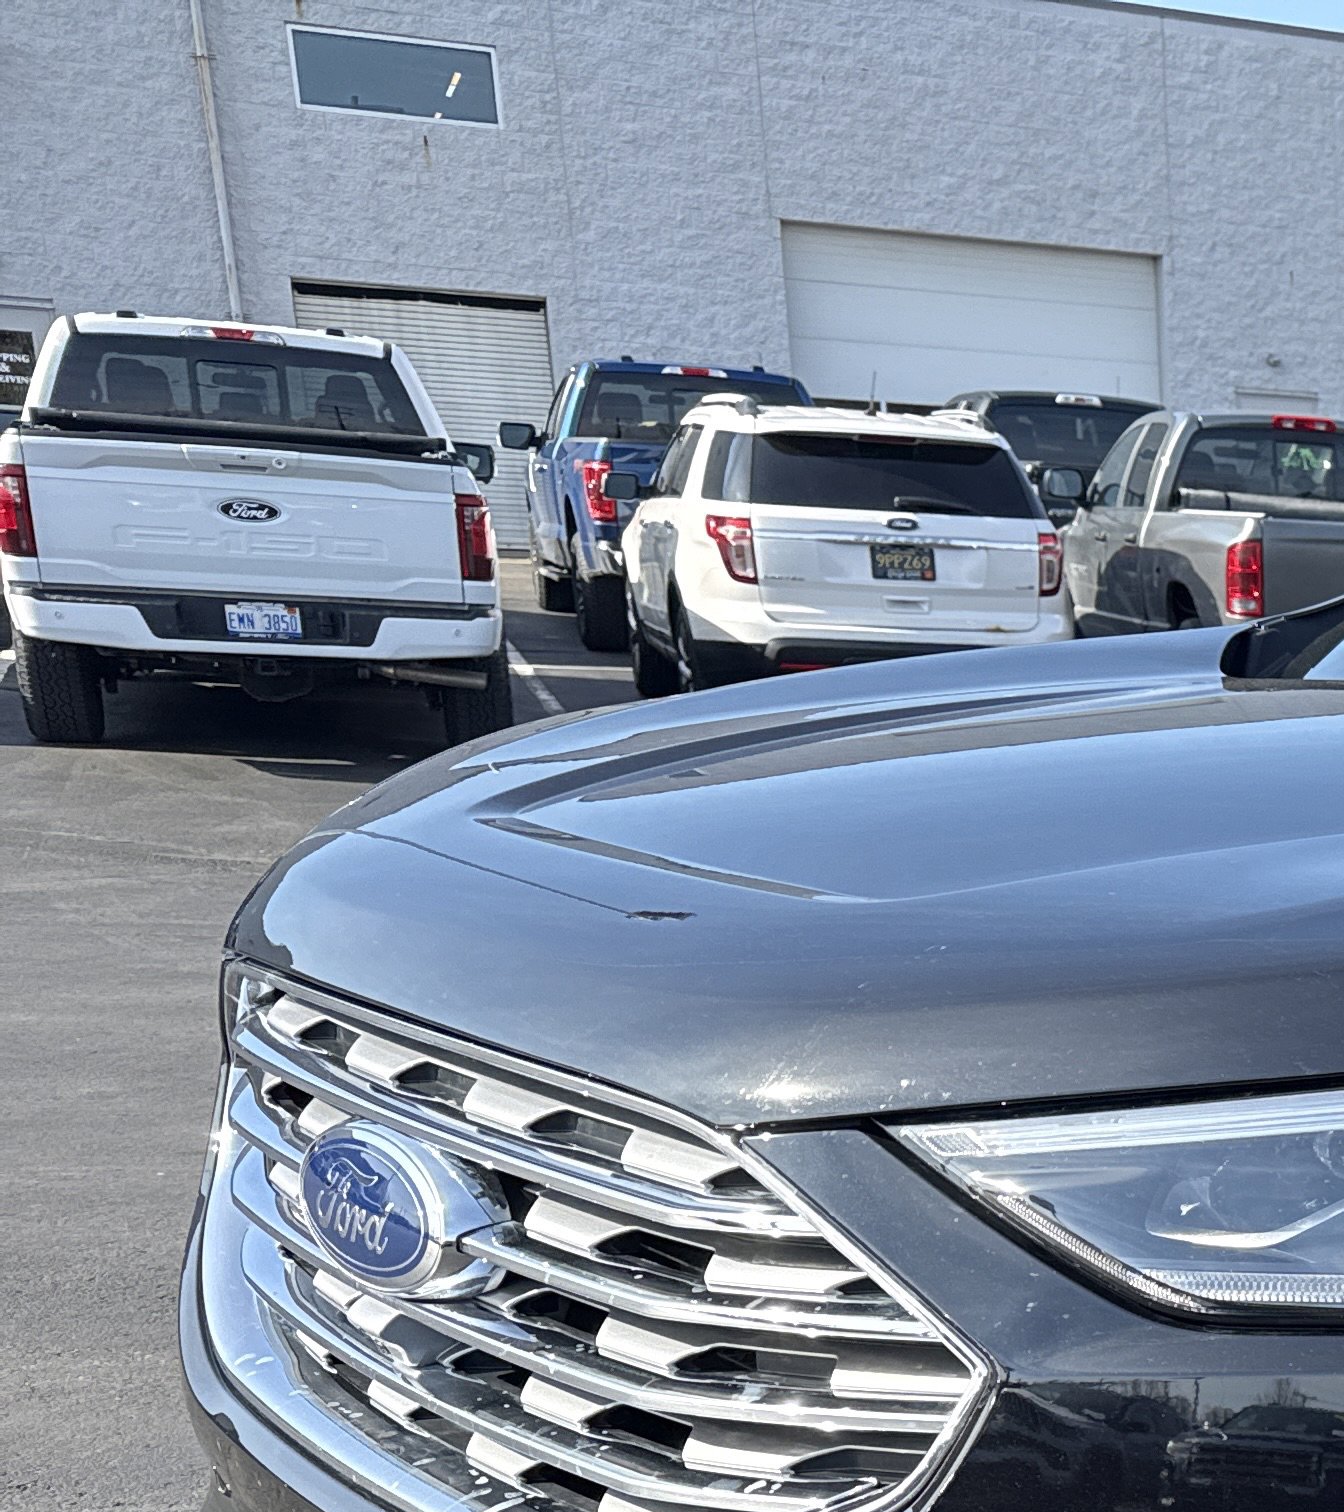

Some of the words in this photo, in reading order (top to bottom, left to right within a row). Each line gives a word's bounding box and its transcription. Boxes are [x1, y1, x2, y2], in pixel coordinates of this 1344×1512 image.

[0, 353, 30, 363] PING
[229, 502, 270, 519] Ford
[112, 523, 390, 562] F-150
[263, 613, 298, 632] 3850
[315, 1156, 396, 1256] Ford
